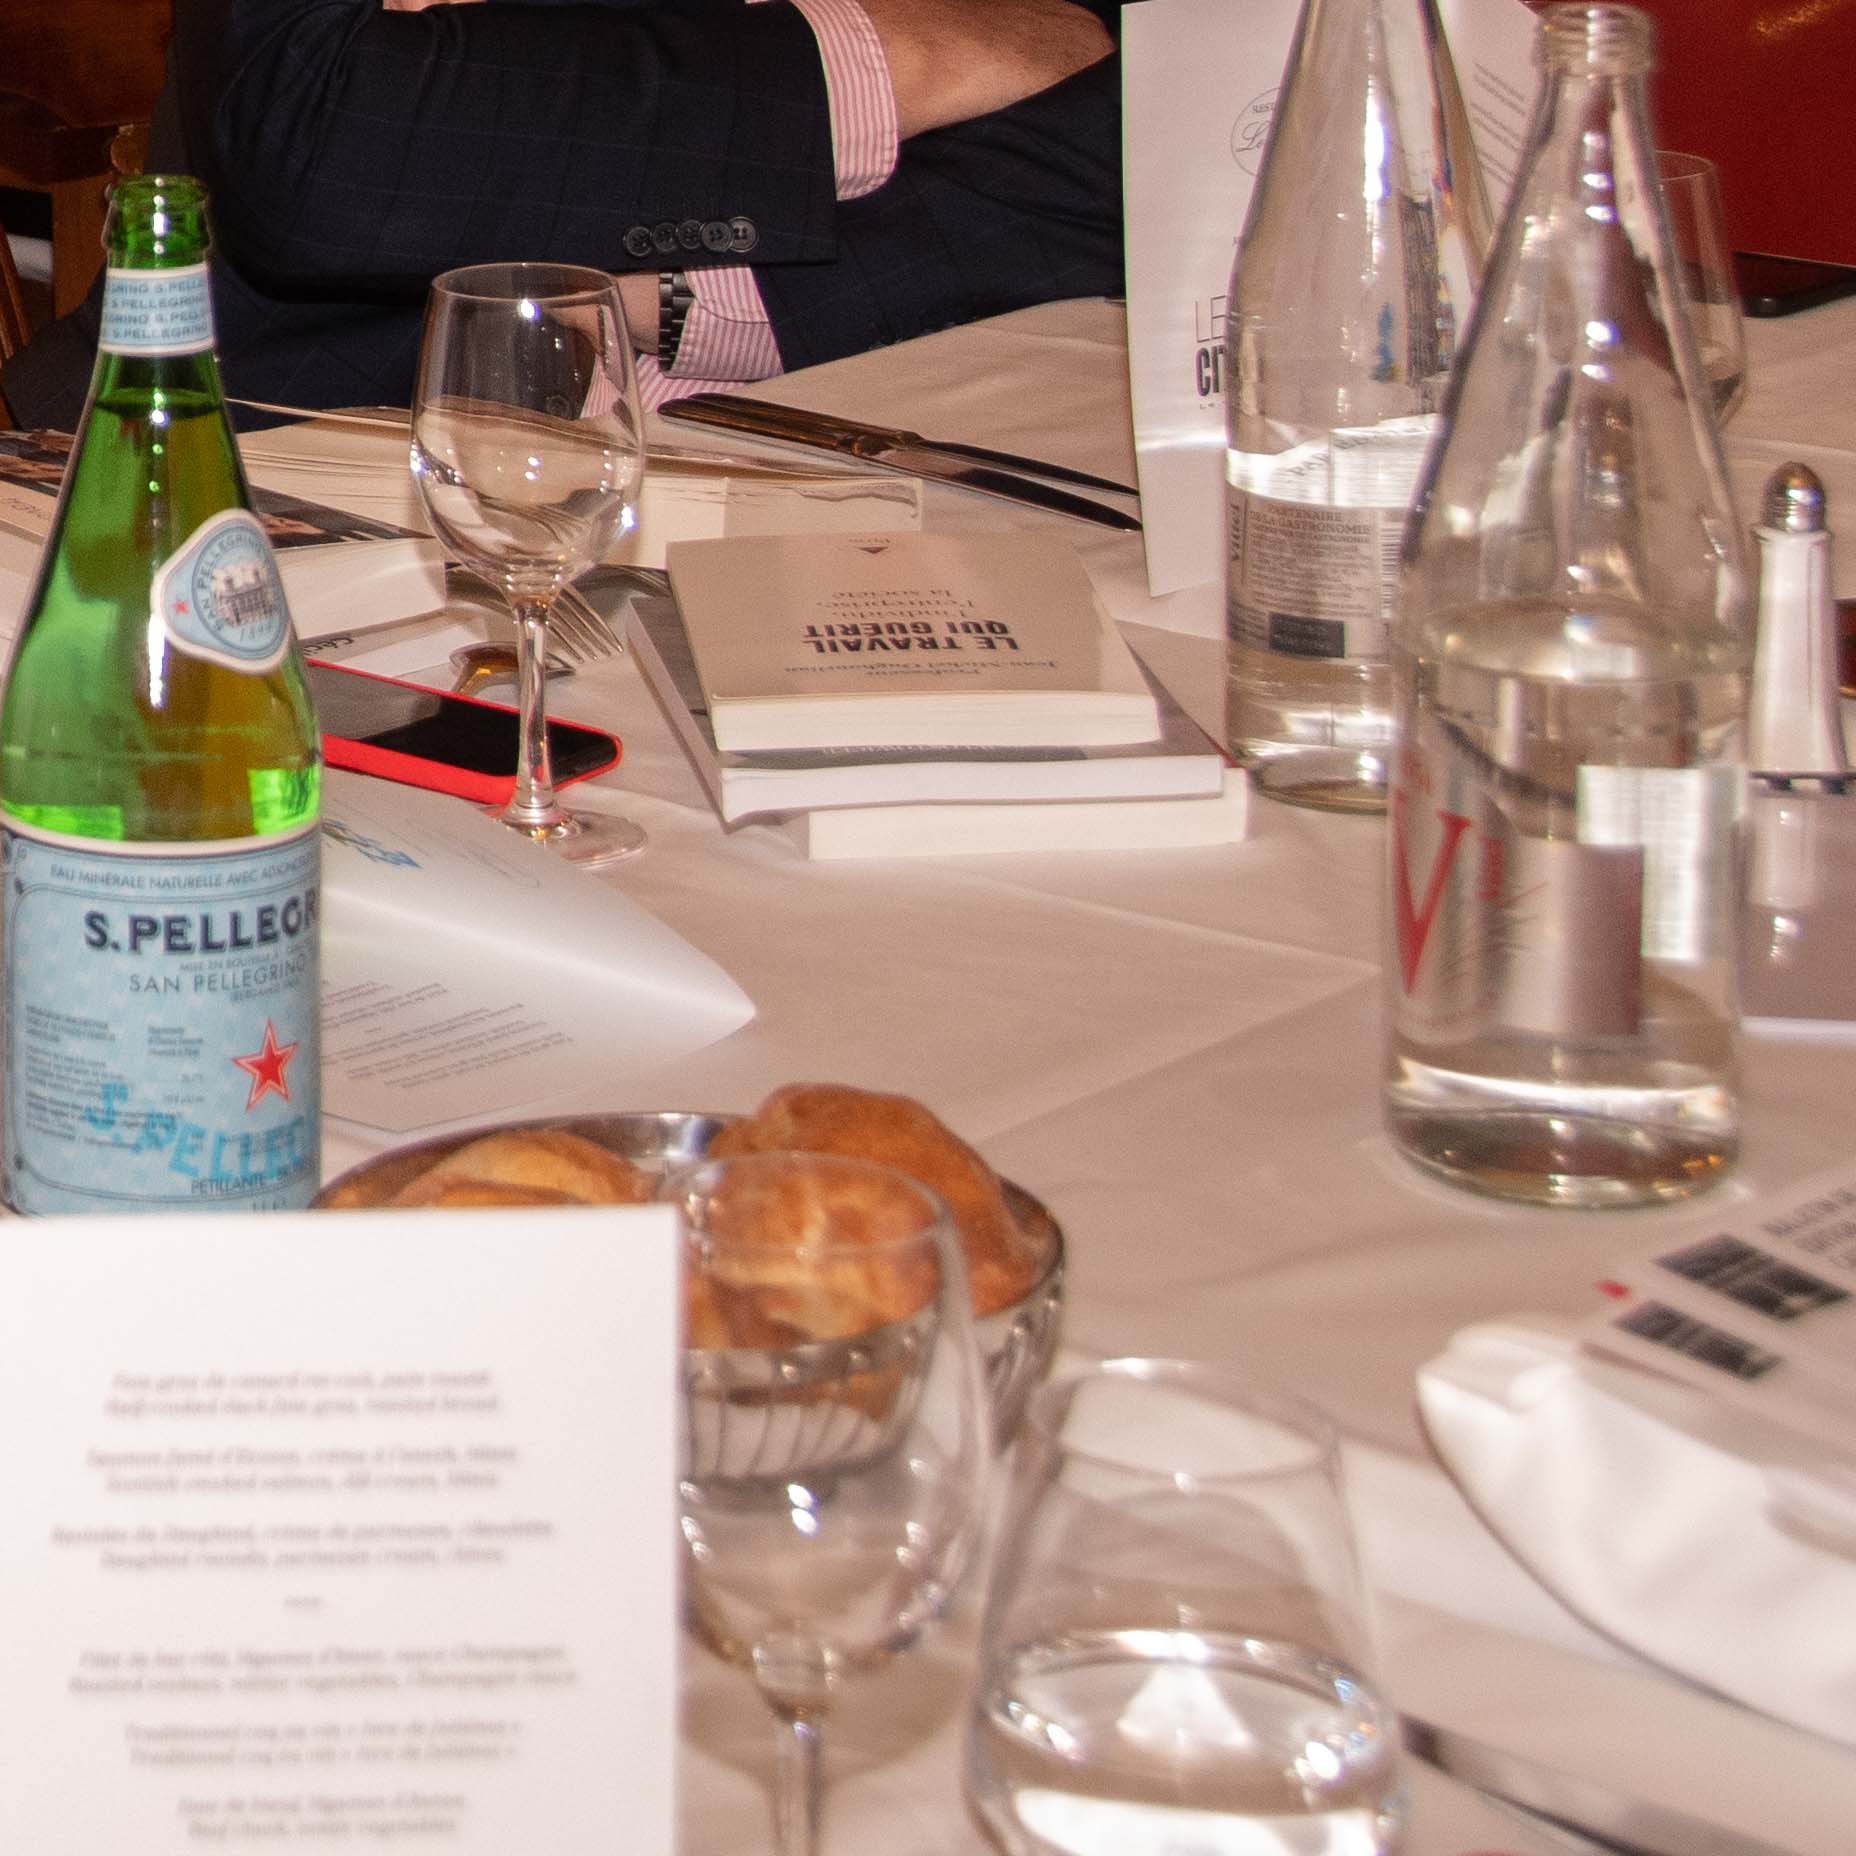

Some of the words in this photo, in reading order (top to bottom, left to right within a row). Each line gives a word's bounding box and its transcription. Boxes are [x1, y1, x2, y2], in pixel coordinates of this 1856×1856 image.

[802, 621, 934, 639] GUÉRIT
[945, 619, 1011, 637] QUI
[802, 636, 963, 654] TRAVAIL
[974, 635, 1020, 651] LE
[128, 973, 181, 993] SAN
[193, 955, 307, 993] PELLEGRINO
